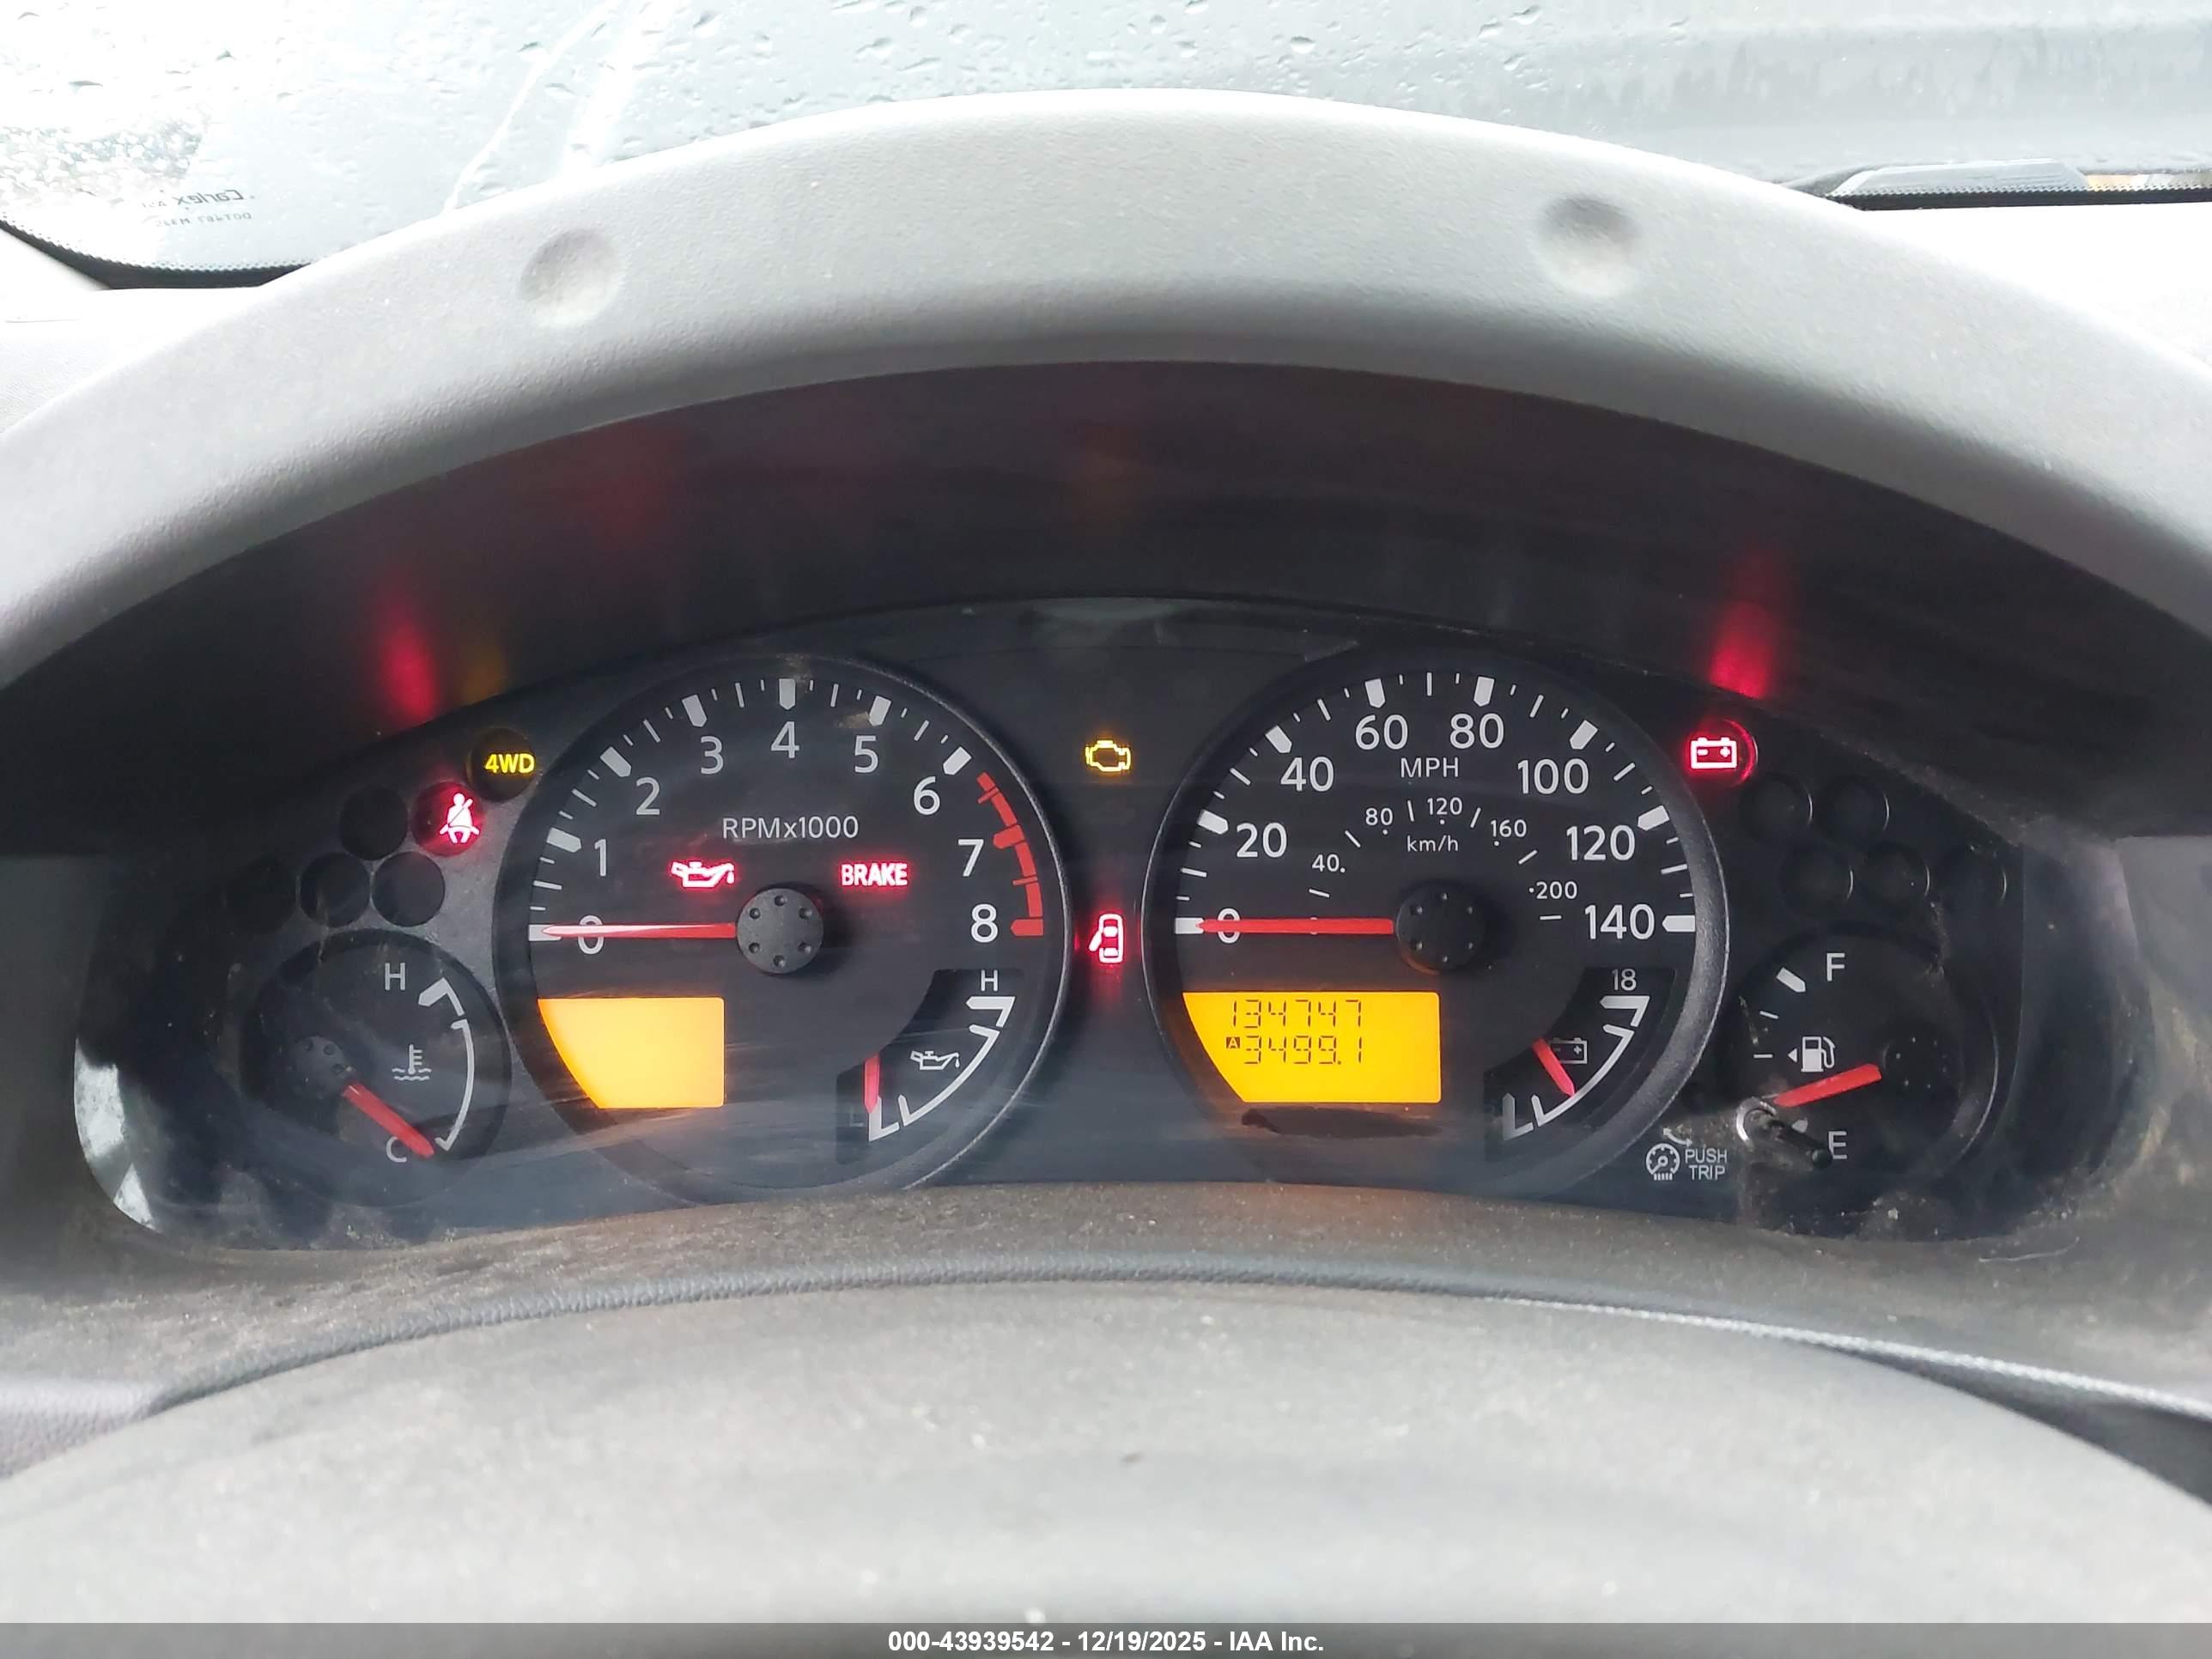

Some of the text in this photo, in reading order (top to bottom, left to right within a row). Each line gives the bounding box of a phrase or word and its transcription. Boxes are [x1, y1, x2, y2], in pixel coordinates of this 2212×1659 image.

[771, 721, 799, 758] 4
[1356, 715, 1407, 750] 60
[1450, 714, 1504, 749] 80
[485, 754, 534, 773] 4WD
[702, 736, 723, 774] 3
[855, 736, 878, 773] 5
[1401, 757, 1458, 777] MPH
[1280, 757, 1334, 792] 40
[1518, 759, 1589, 793] 100
[636, 777, 659, 815] 2
[915, 776, 939, 815] 6
[1428, 798, 1462, 814] 120
[724, 817, 858, 838] RPMx1000
[1366, 808, 1392, 825] 80
[1491, 819, 1526, 837] 160
[1237, 823, 1286, 857] 20
[1407, 836, 1458, 851] km/h
[1567, 824, 1635, 860] 120
[595, 840, 606, 876] 1
[958, 839, 983, 876] 7
[1312, 854, 1339, 872] 40
[842, 863, 907, 885] BRAKE
[1537, 882, 1577, 898] 200
[577, 915, 605, 955] 0
[971, 904, 998, 942] 8
[1217, 908, 1242, 943] 0
[1585, 904, 1654, 939] 140
[386, 963, 405, 990] H
[981, 970, 998, 991] H
[1615, 969, 1636, 990] 18
[1827, 953, 1844, 981] F
[1231, 1000, 1362, 1028] 134747
[1243, 1036, 1362, 1065] 3499.1
[386, 1135, 408, 1163] C
[1685, 1148, 1728, 1164] PUSH
[1829, 1132, 1847, 1158] E
[1689, 1165, 1725, 1179] TRIP
